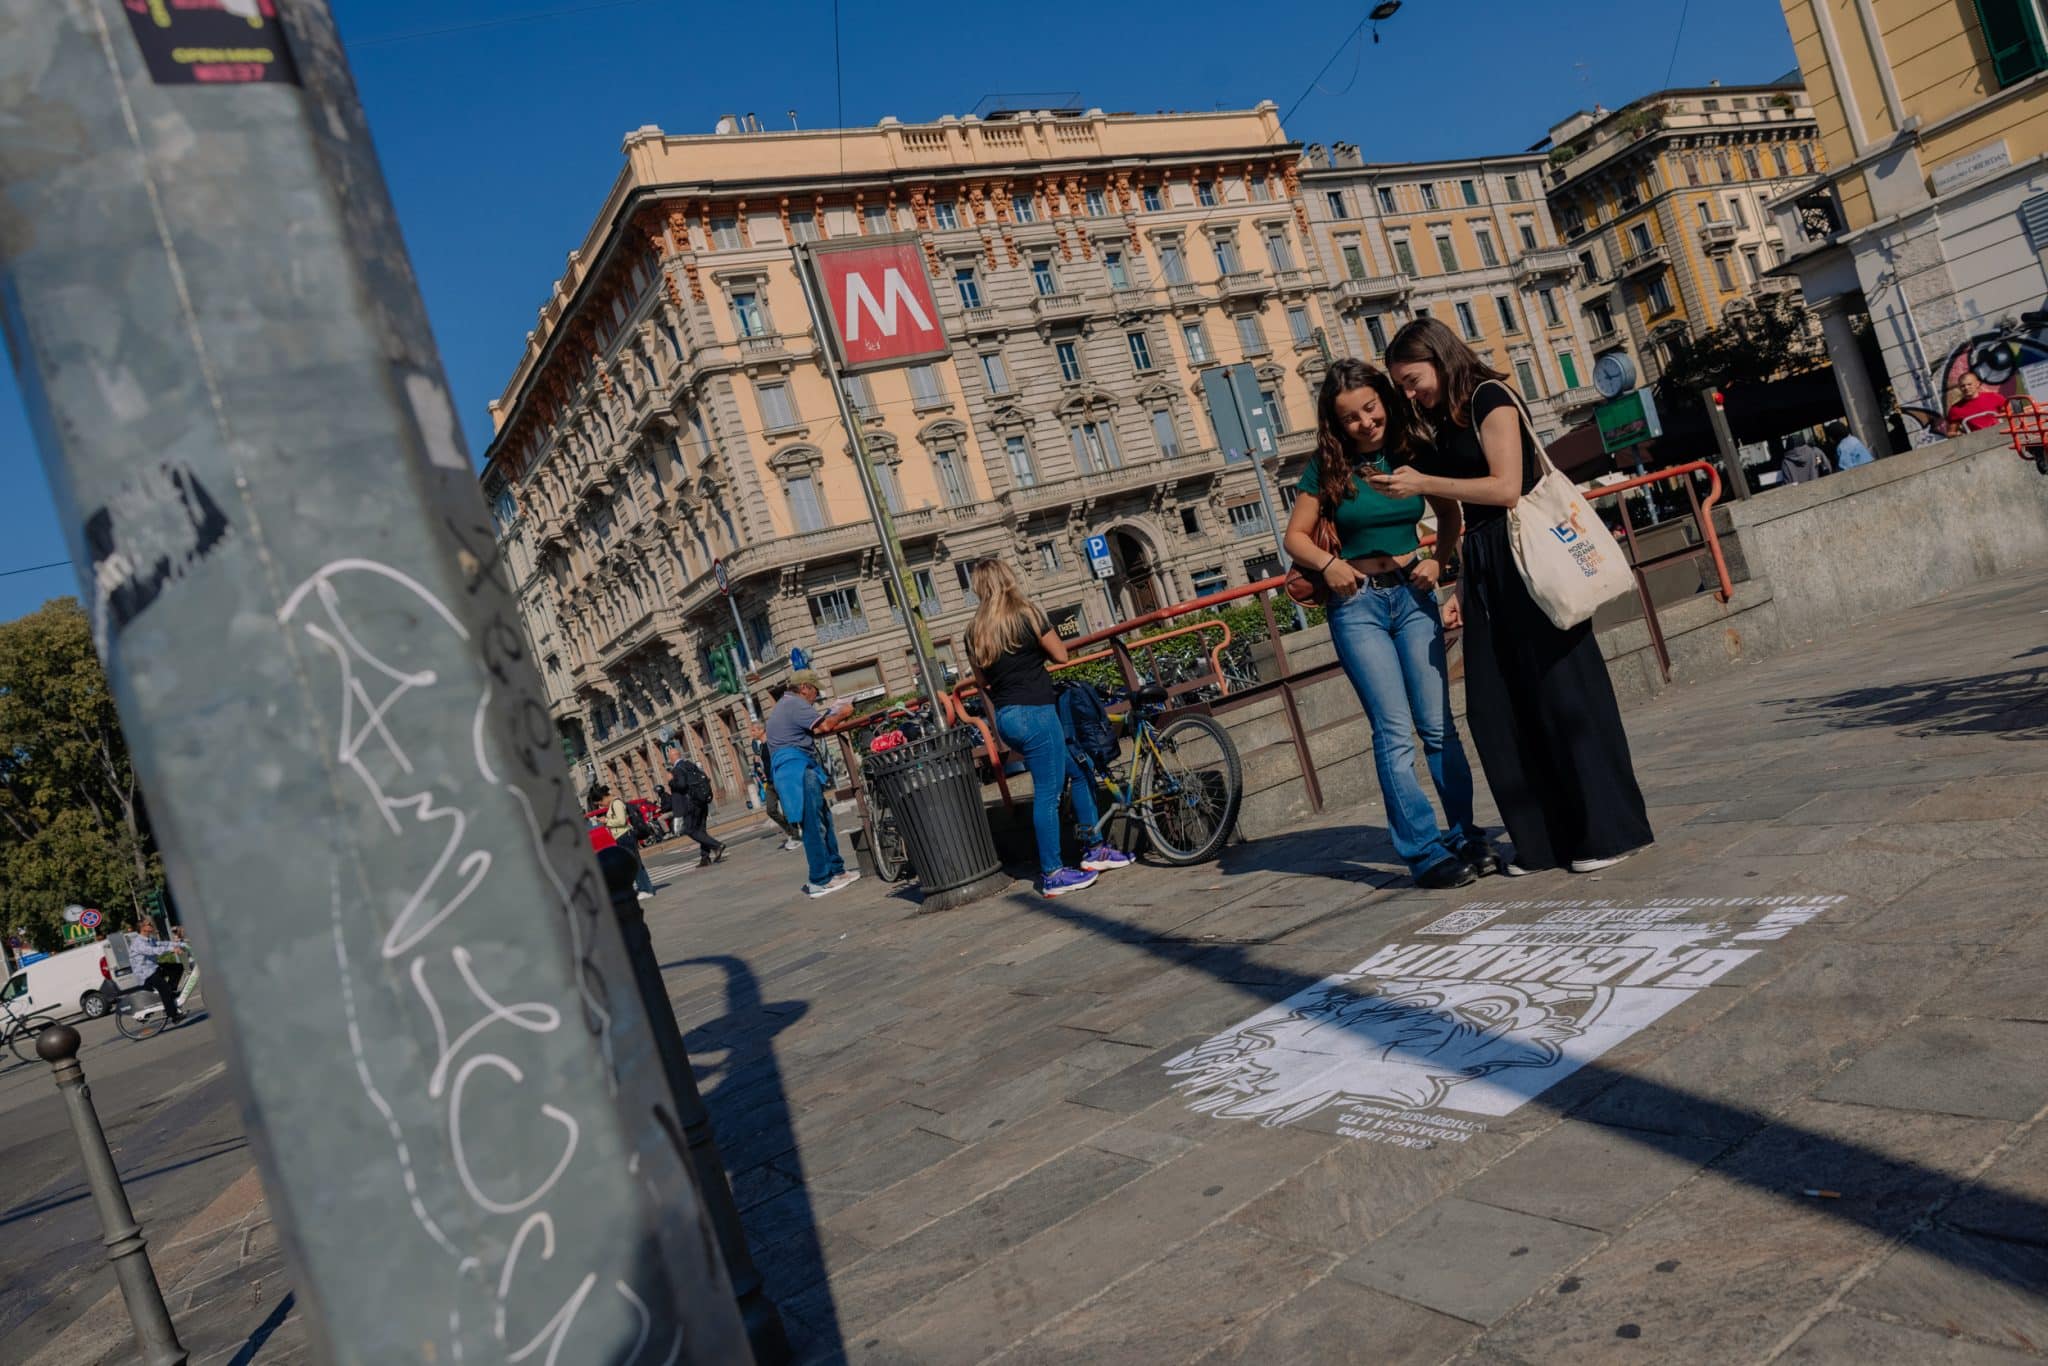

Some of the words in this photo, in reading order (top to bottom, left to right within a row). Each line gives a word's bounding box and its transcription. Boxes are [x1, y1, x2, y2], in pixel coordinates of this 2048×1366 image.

[846, 268, 934, 342] M
[1090, 539, 1103, 557] P
[1504, 932, 1591, 944] URANA
[1587, 932, 1636, 945] KEI
[1349, 943, 1762, 987] GACHIAKUTA
